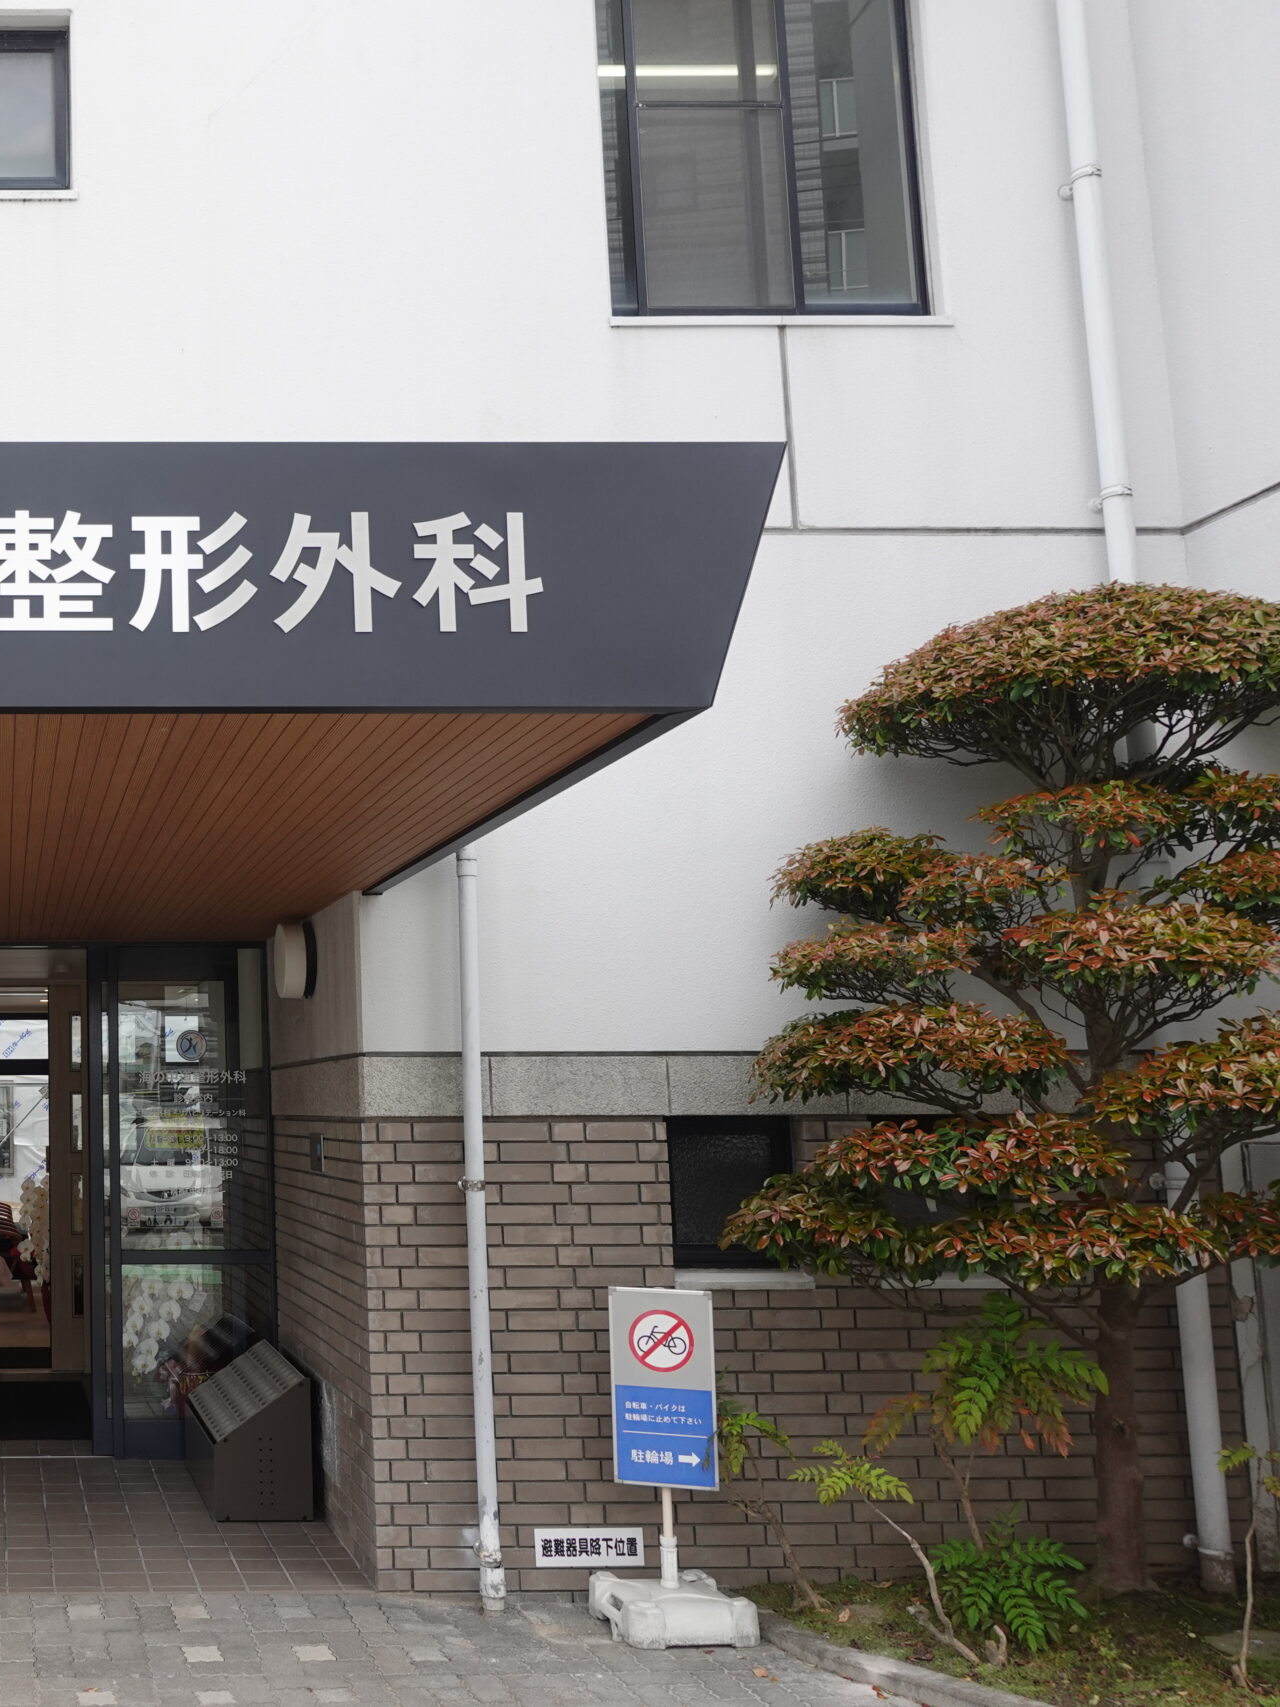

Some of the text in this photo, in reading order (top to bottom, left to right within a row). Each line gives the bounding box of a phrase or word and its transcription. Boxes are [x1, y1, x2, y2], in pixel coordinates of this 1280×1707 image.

[624, 1412, 703, 1425] 駐輪場に止めて下さい
[630, 1448, 674, 1466] 駐輪場
[540, 1537, 639, 1558] 避難器具降下位置
